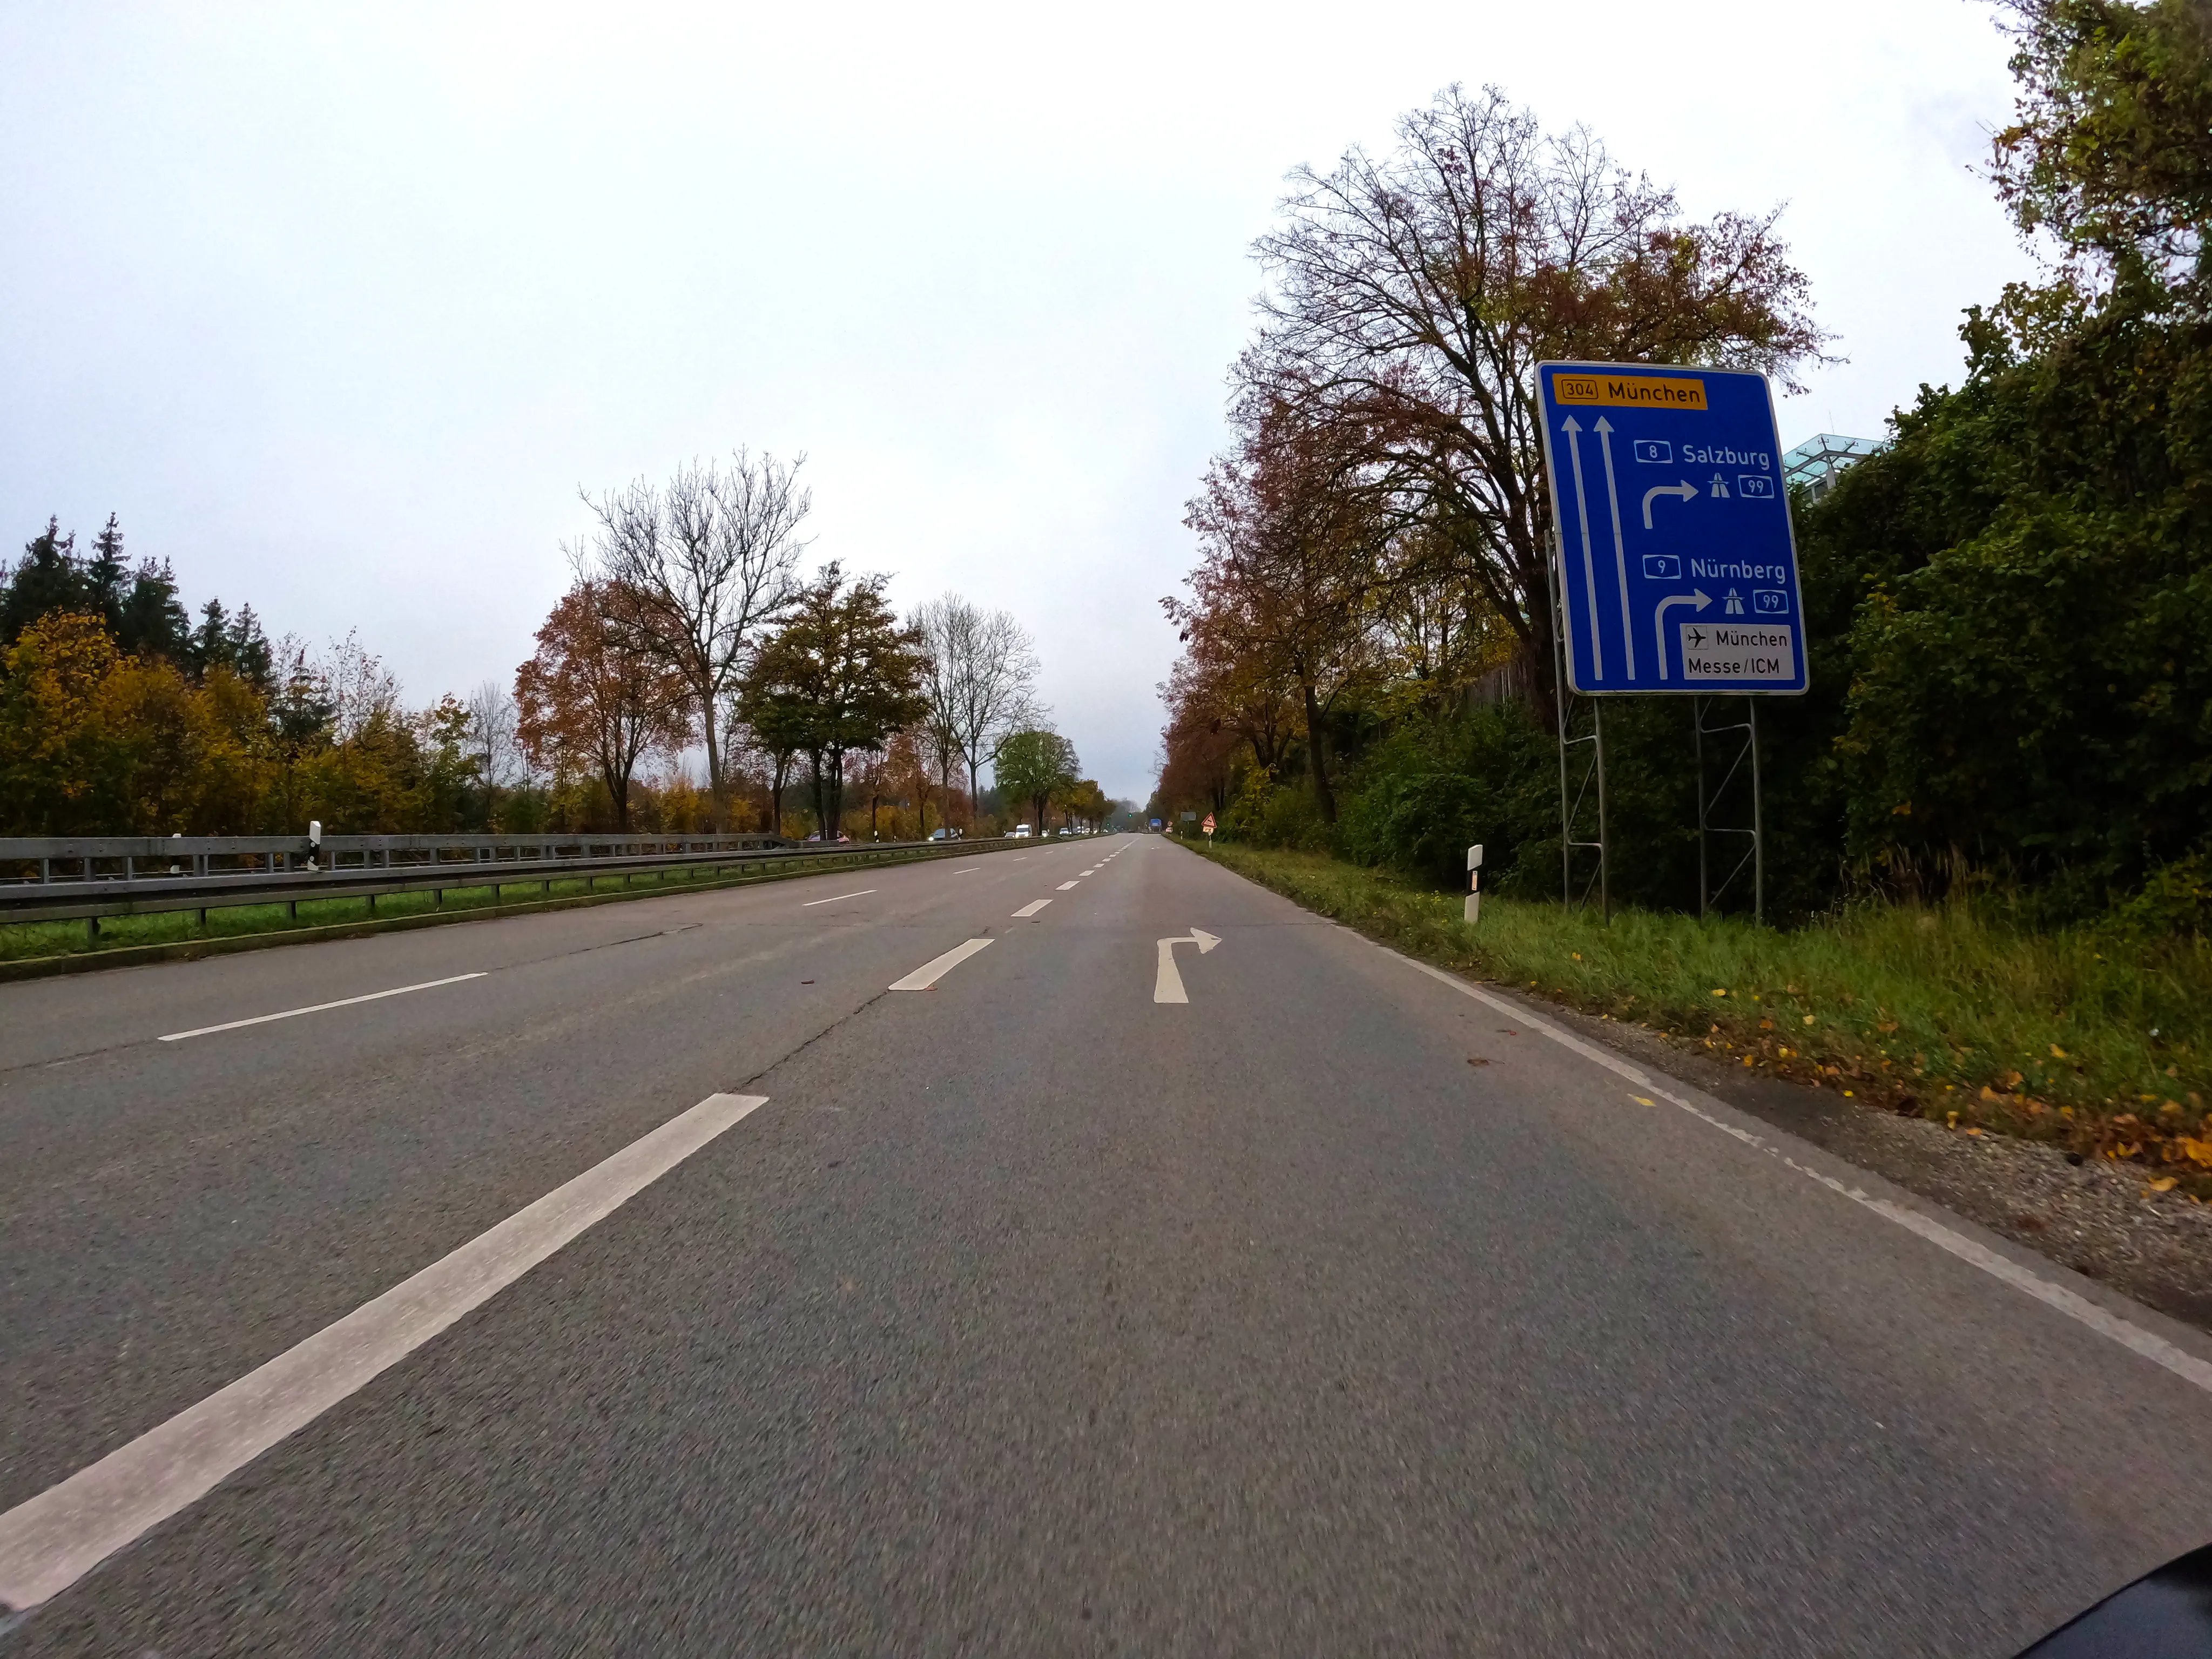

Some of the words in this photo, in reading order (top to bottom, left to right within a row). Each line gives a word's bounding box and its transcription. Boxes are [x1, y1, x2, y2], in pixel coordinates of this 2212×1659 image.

[1566, 383, 1593, 395] 304
[1608, 382, 1700, 402] München
[1649, 445, 1658, 458] 8
[1683, 444, 1770, 470] Salzburg
[1748, 480, 1764, 493] 99
[1658, 559, 1666, 574] 9
[1691, 558, 1785, 584] Nürnberg
[1763, 595, 1779, 608] 99
[1716, 630, 1787, 646] München
